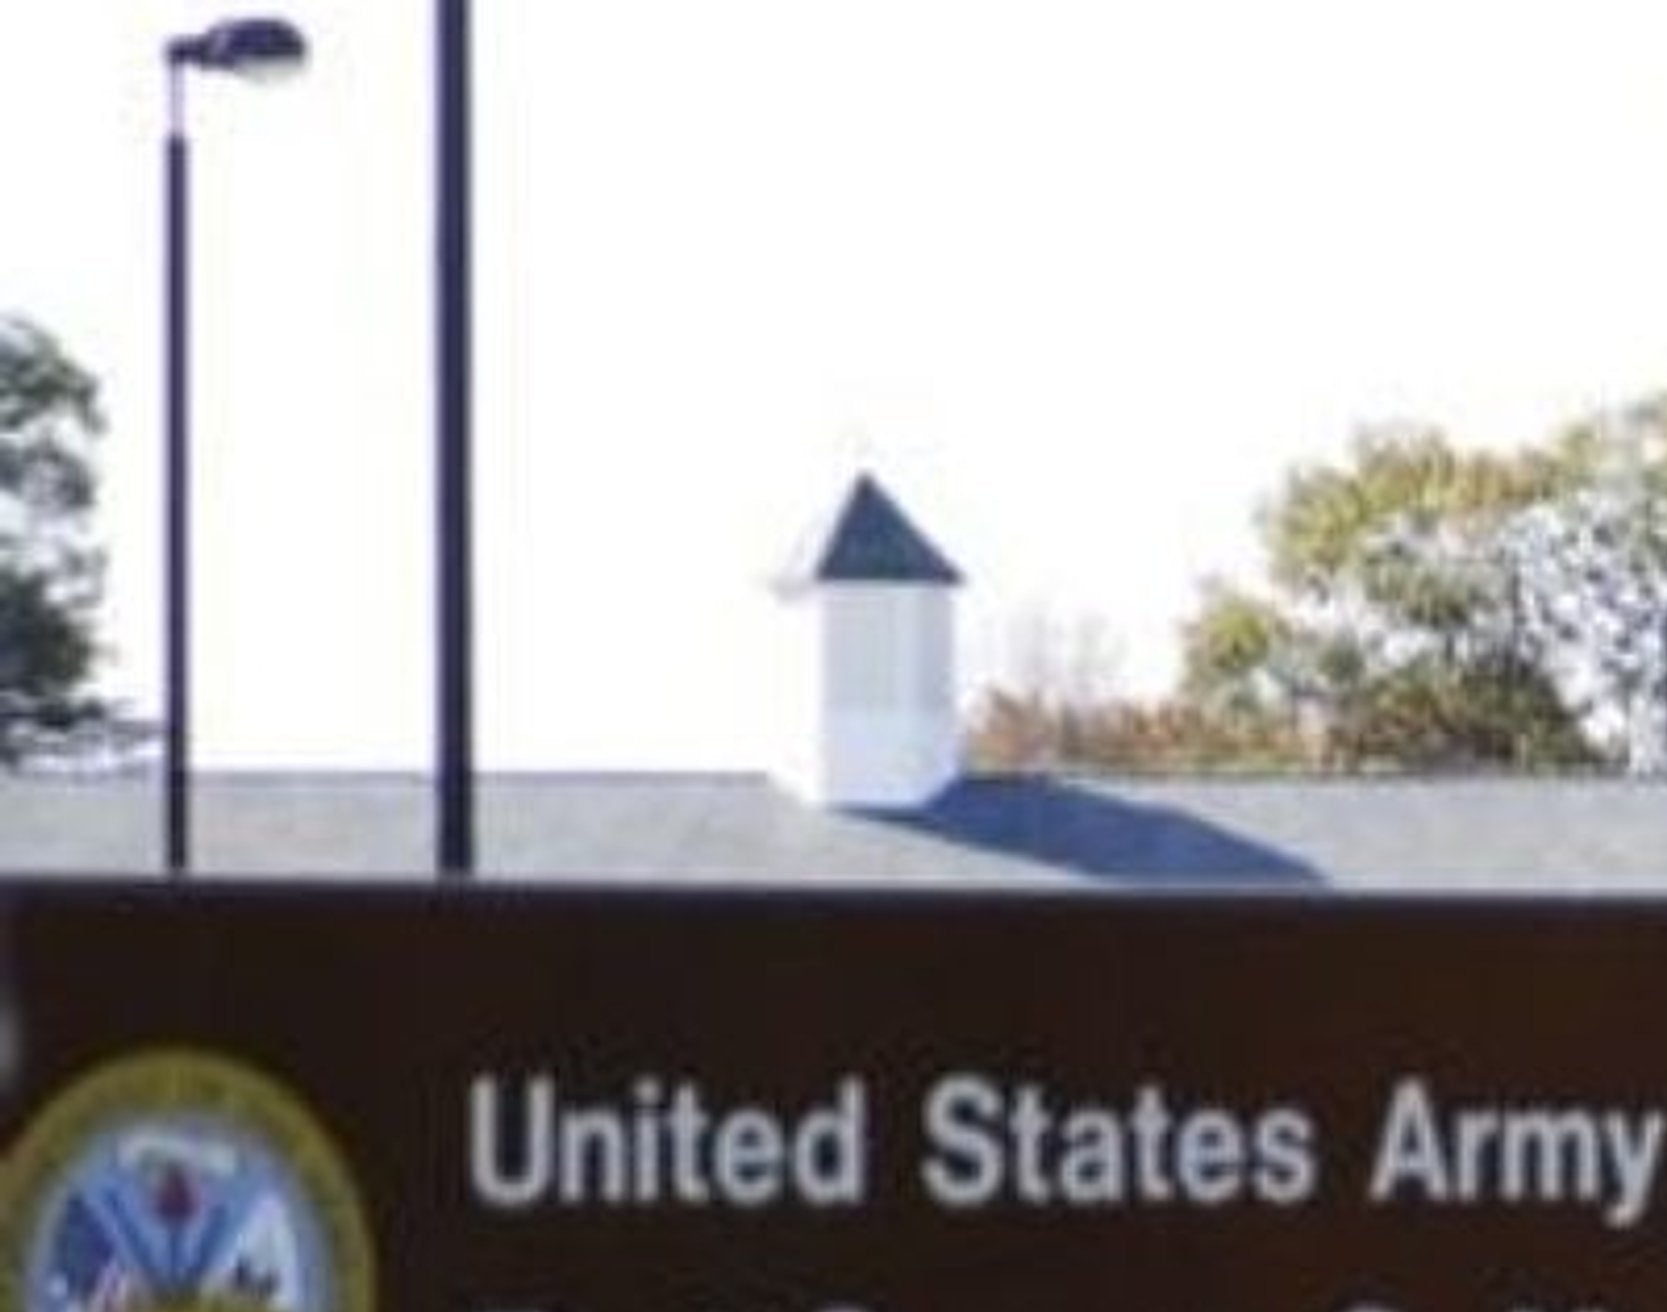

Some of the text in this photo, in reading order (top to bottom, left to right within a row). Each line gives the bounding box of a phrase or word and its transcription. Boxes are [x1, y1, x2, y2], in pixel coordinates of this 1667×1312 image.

[472, 1076, 1666, 1225] United States Army
